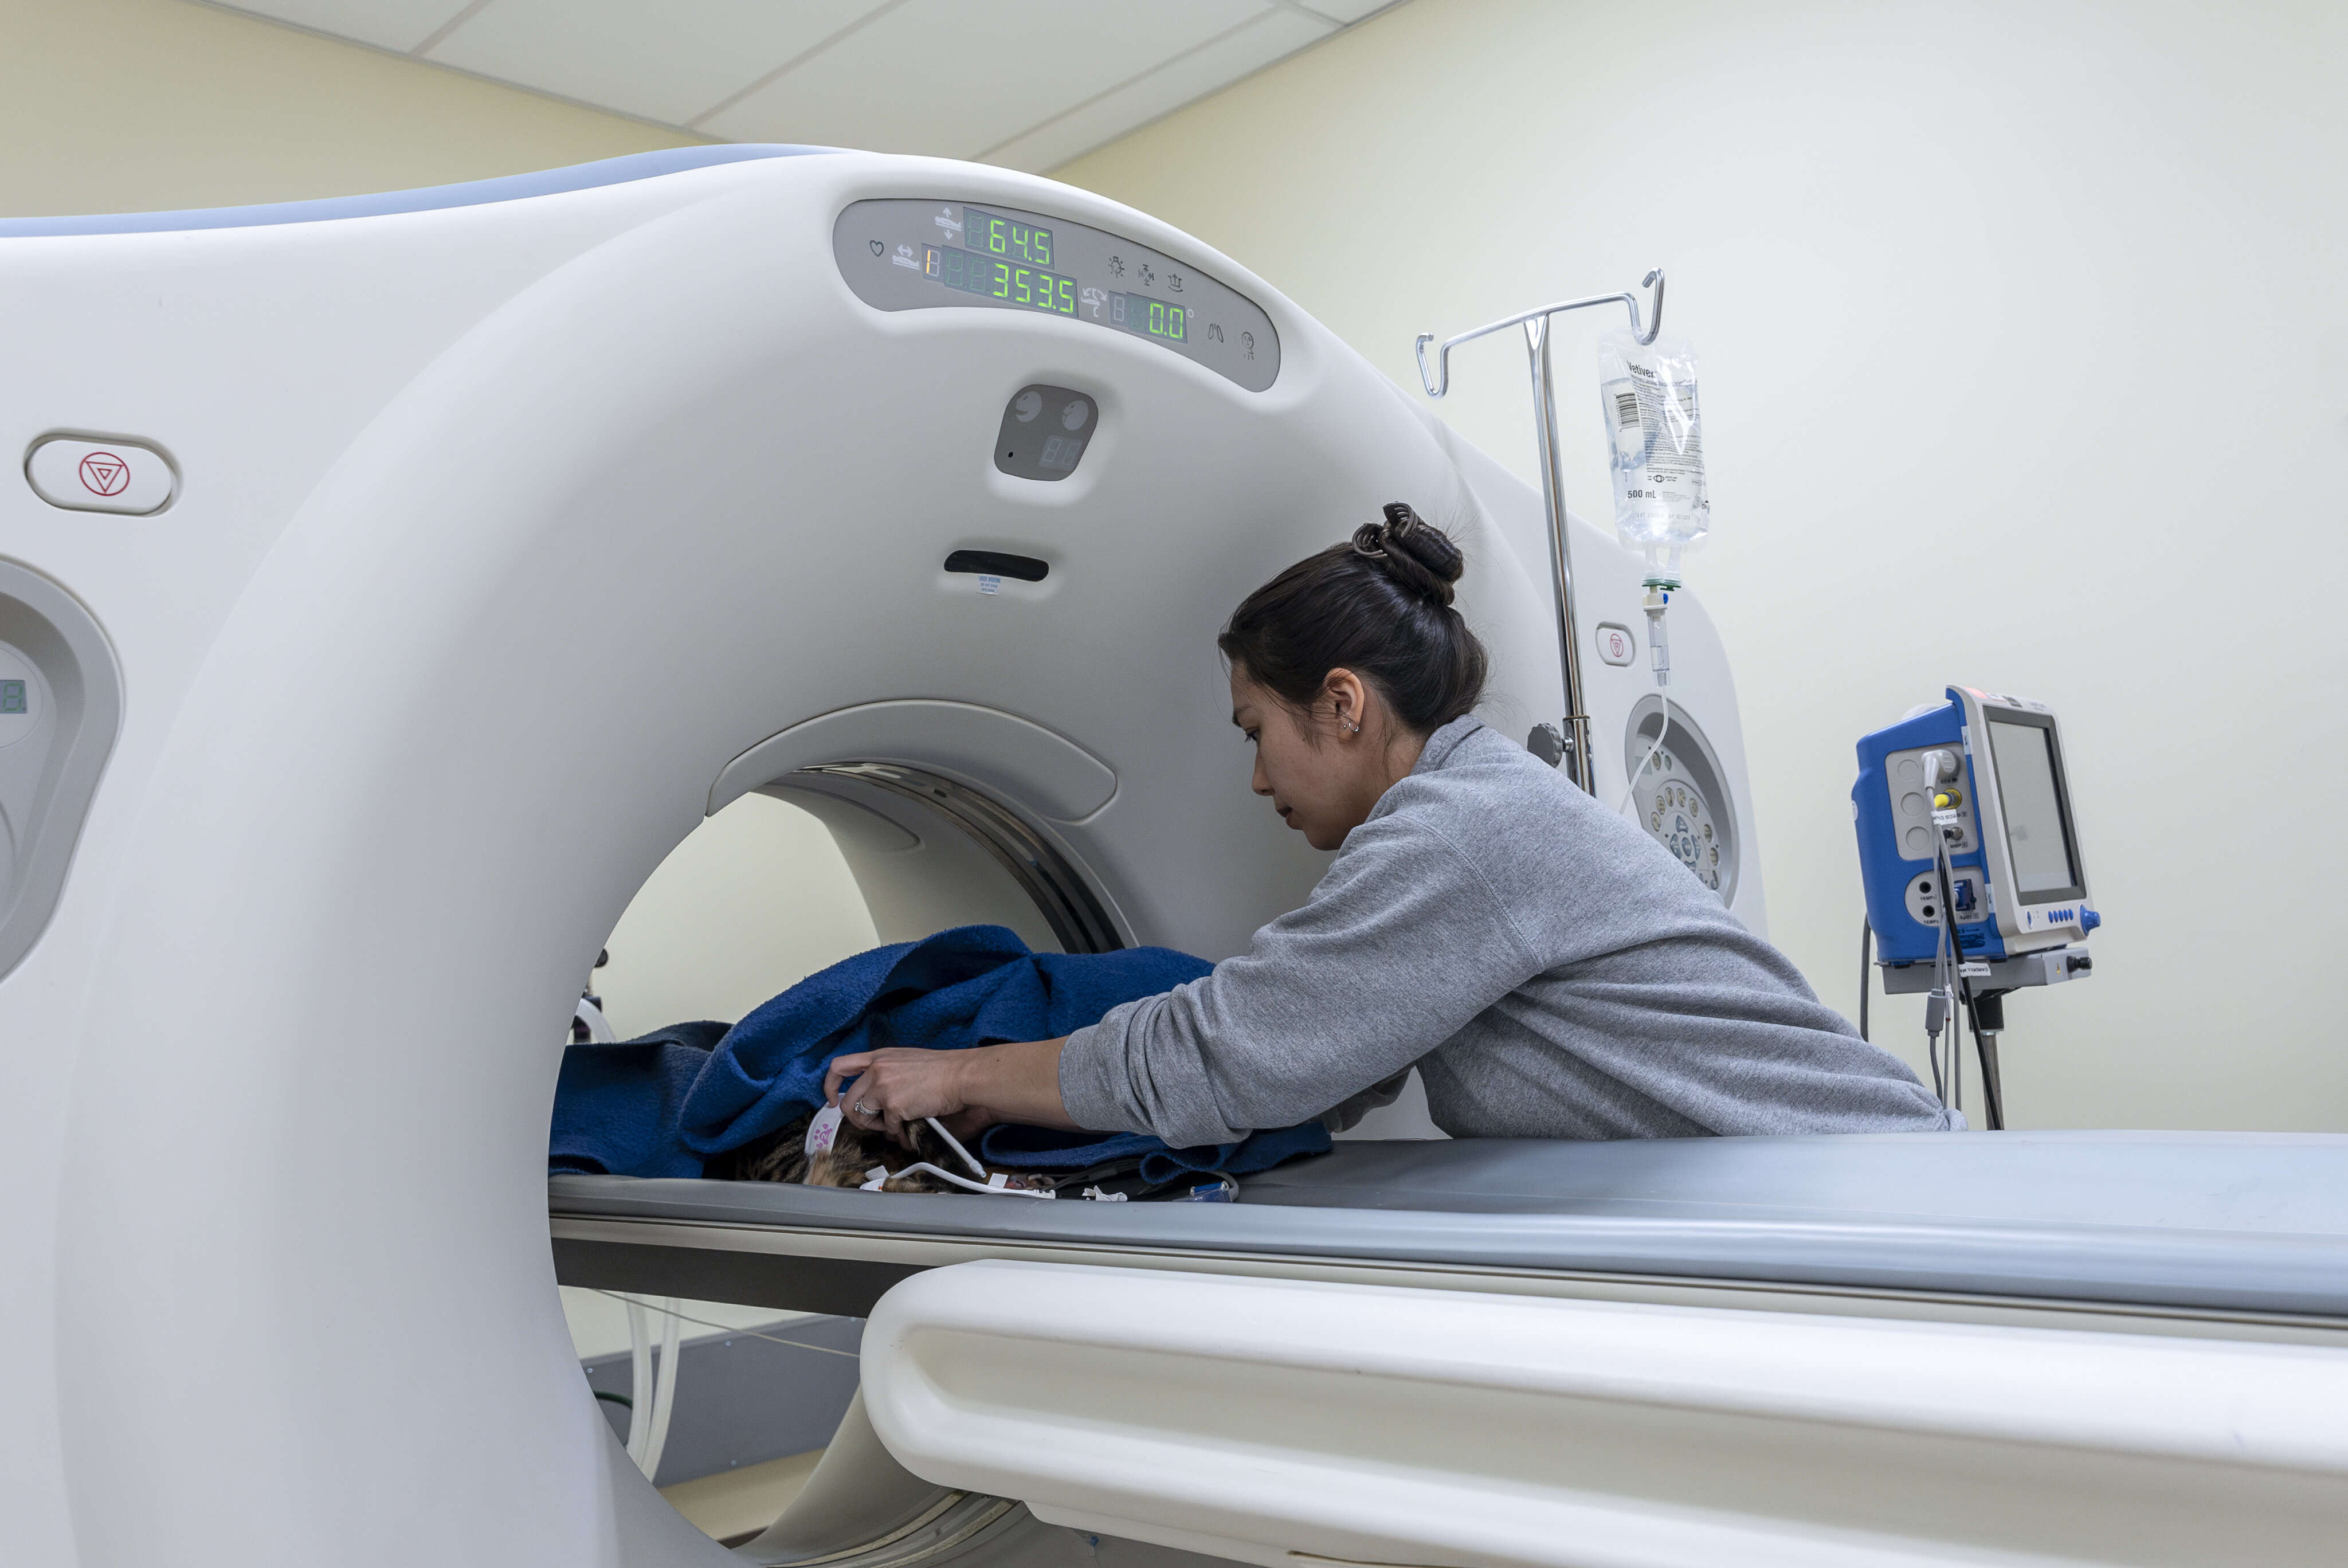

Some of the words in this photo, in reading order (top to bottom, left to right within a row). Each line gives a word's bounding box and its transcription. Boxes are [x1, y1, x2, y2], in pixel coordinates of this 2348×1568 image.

[989, 219, 1049, 265] 64.5
[993, 262, 1074, 313] 353.5
[1626, 360, 1656, 378] Vetivex
[1628, 489, 1643, 499] 500
[1645, 490, 1656, 498] mL
